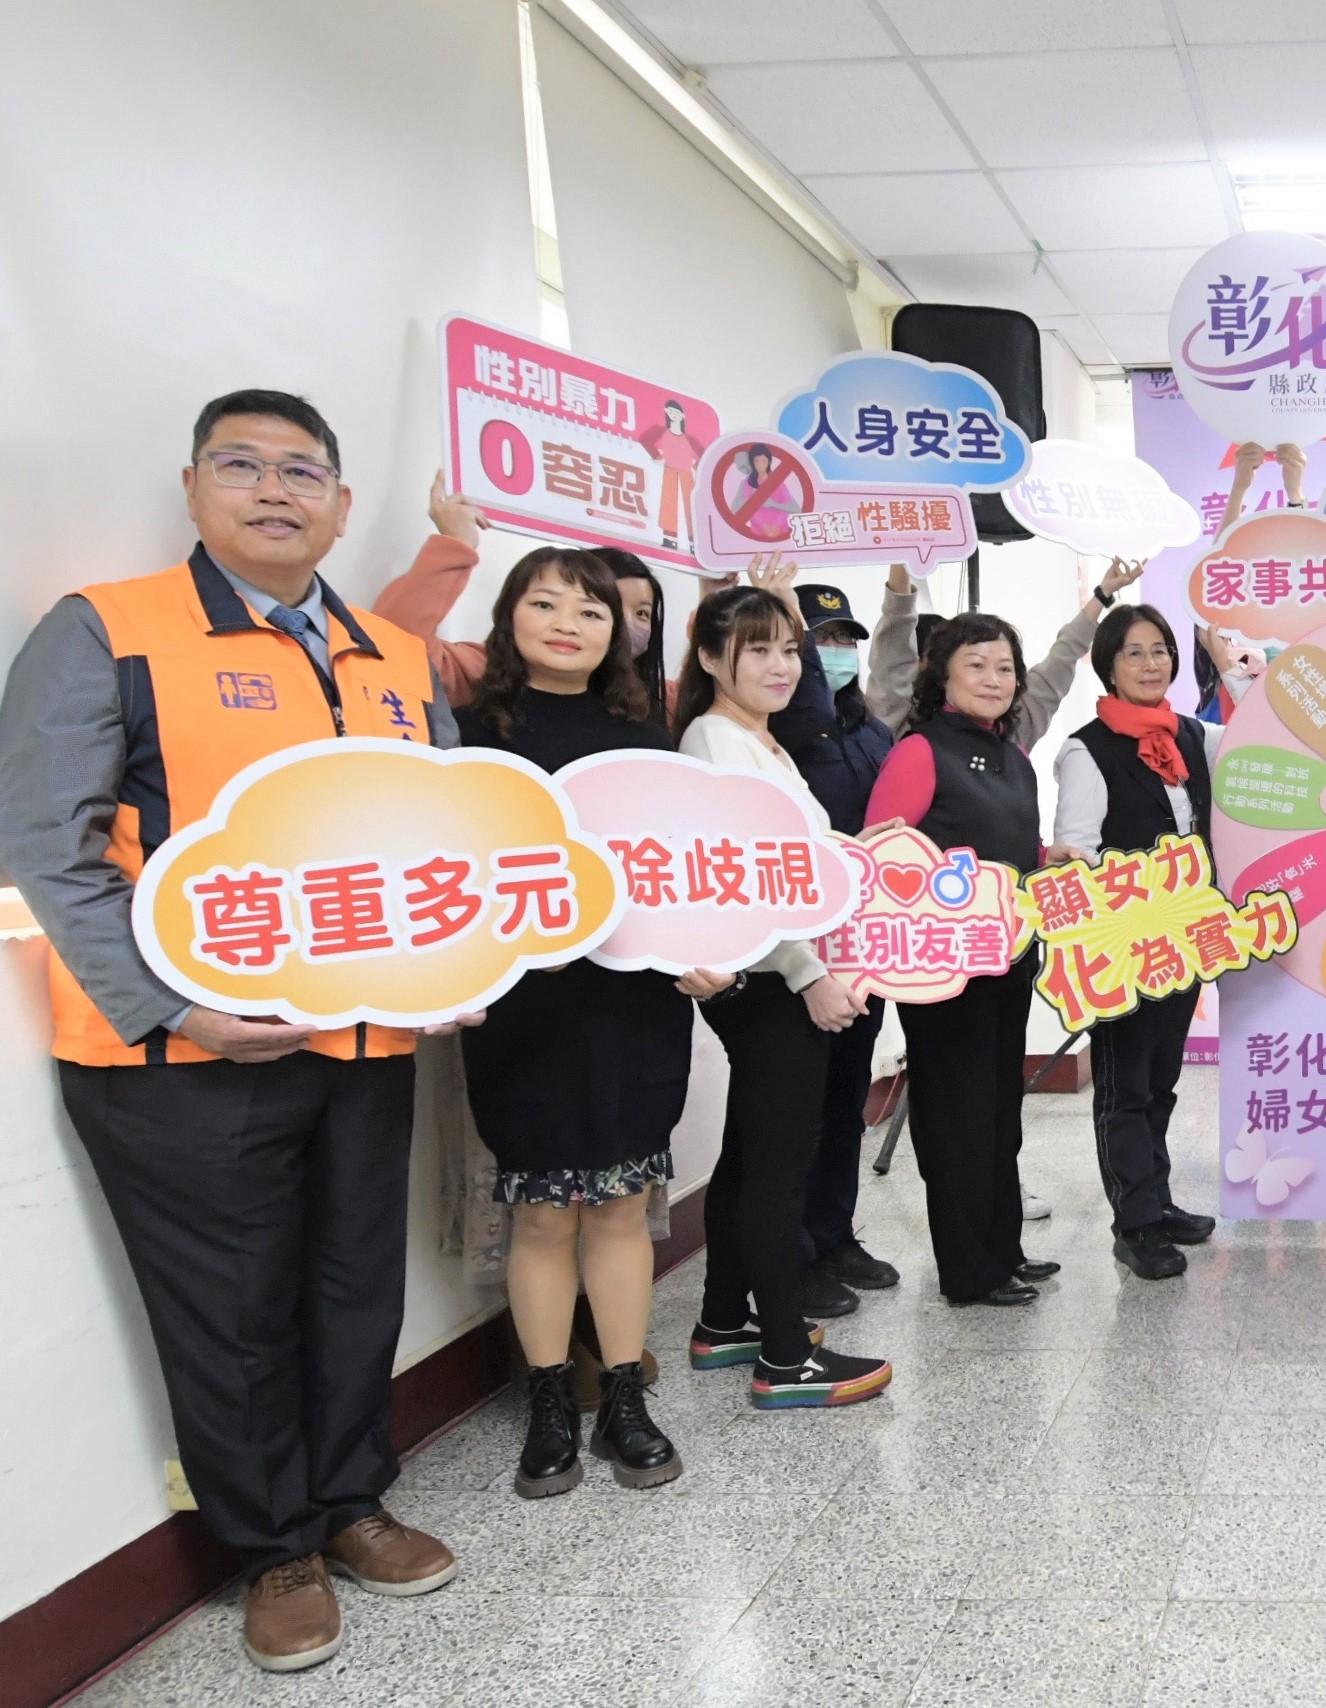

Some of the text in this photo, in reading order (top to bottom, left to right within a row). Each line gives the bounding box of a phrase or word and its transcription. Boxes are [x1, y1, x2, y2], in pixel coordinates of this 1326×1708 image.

[473, 344, 637, 432] 性別暴力
[803, 401, 1004, 462] 人身安全
[479, 418, 648, 518] 0 容忍
[789, 500, 952, 549] 拒絕 性騷擾
[193, 852, 573, 967] 尊重多元
[606, 837, 819, 908] 除歧視
[1031, 841, 1203, 932] 顯女力
[816, 921, 1004, 968] 性別友善
[1046, 899, 1289, 1023] 化為實力
